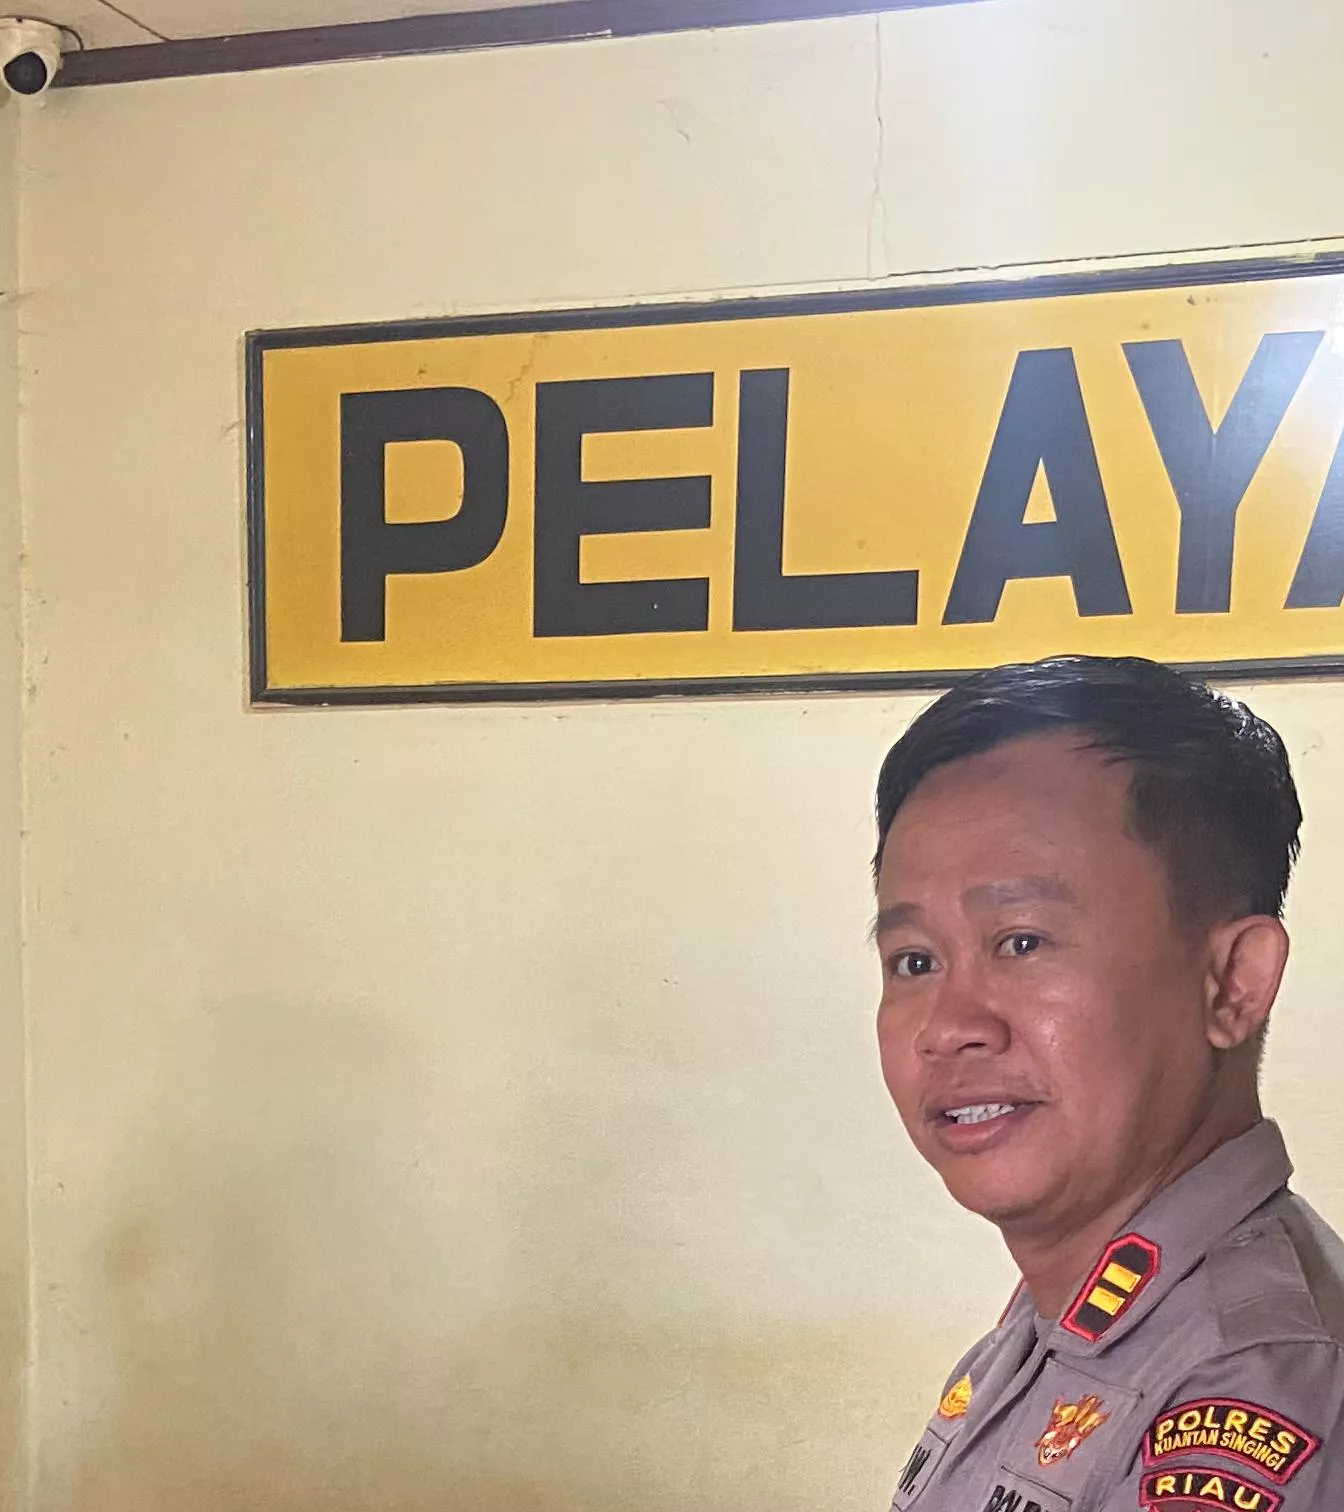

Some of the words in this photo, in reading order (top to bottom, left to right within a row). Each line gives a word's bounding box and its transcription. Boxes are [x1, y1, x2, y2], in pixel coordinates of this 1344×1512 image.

[1154, 1429, 1218, 1456] KUANTAN
[1219, 1430, 1286, 1471] SINGINGI
[1156, 1406, 1296, 1454] POLRES
[1155, 1473, 1261, 1510] RIAU
